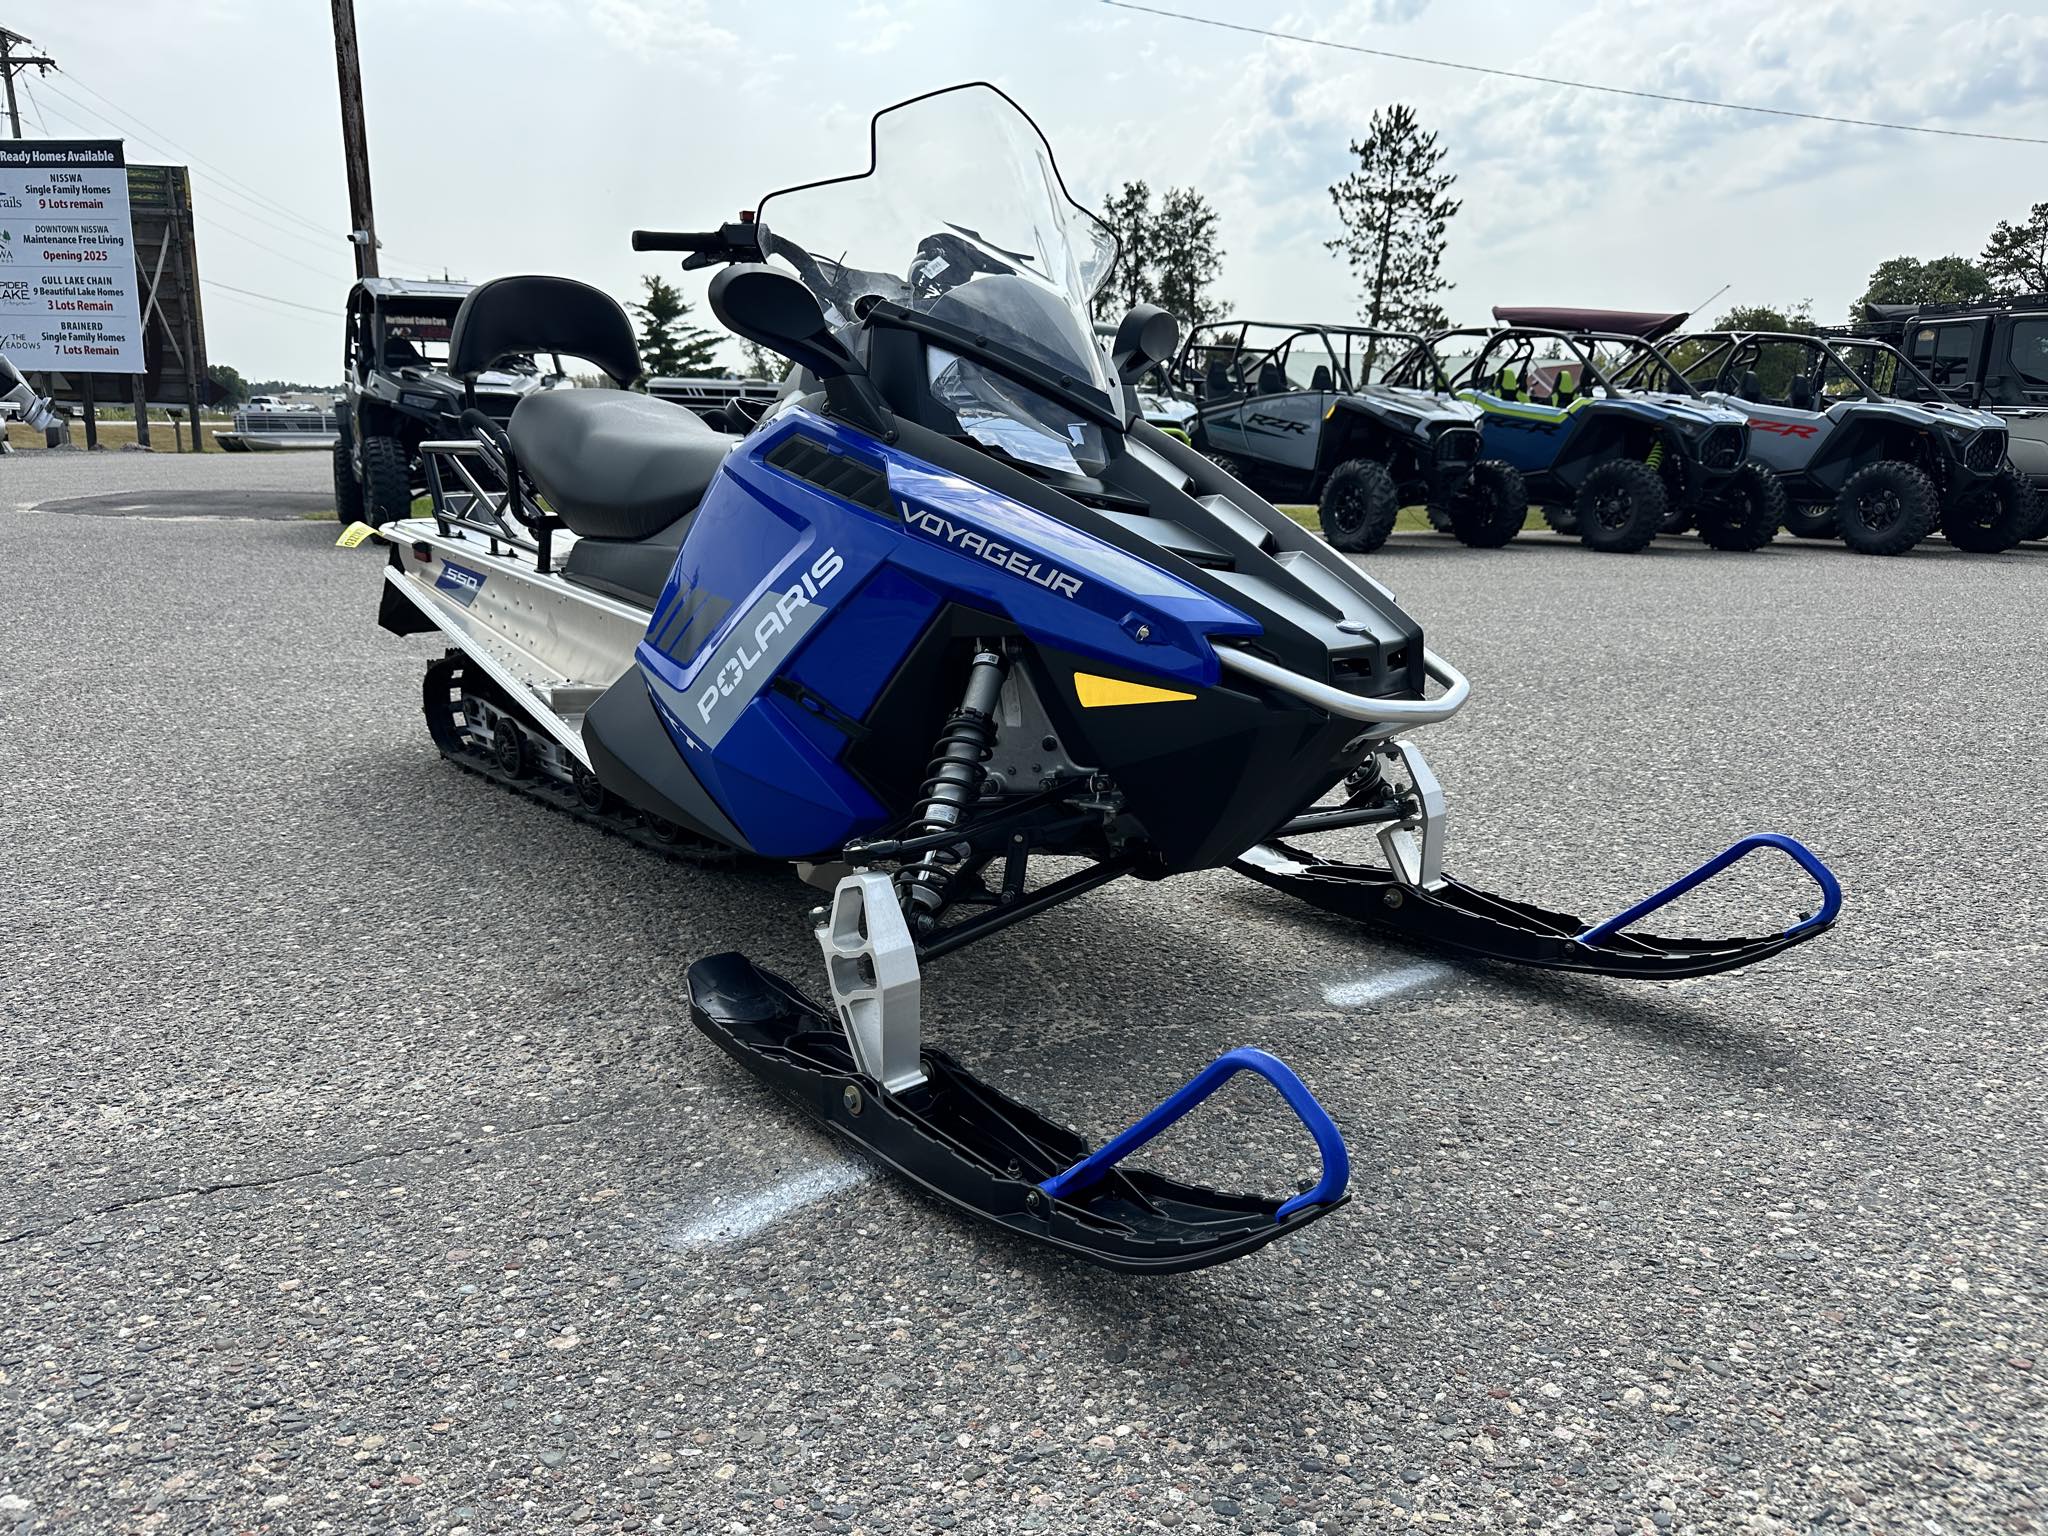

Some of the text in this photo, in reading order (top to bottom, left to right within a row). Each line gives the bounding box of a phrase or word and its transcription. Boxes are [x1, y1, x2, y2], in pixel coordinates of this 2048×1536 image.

[0, 150, 115, 164] Ready Homes Available
[50, 173, 82, 183] NISSWA
[25, 185, 111, 196] Single Family Homes
[39, 199, 104, 209] 9 Lots remain
[35, 225, 109, 234] DOWNTOWN NISSWA
[23, 234, 124, 246] Maintenance Free Living
[43, 250, 108, 262] Opening 2025
[41, 276, 113, 285] GULL LAKE CHAIN
[0, 290, 30, 300] AKE
[33, 287, 124, 297] 9 Beautiful Lake Homes
[47, 300, 54, 310] 3
[55, 300, 76, 311] Lots
[77, 300, 114, 311] Remain
[61, 322, 103, 331] BRAINERD
[41, 332, 126, 343] Single Family Homes
[54, 345, 119, 356] 7 Lots Remain
[1247, 413, 1311, 435] RZR
[901, 501, 1083, 599] VOYAGEUR
[446, 567, 478, 591] 550
[697, 547, 844, 724] POLARIS
